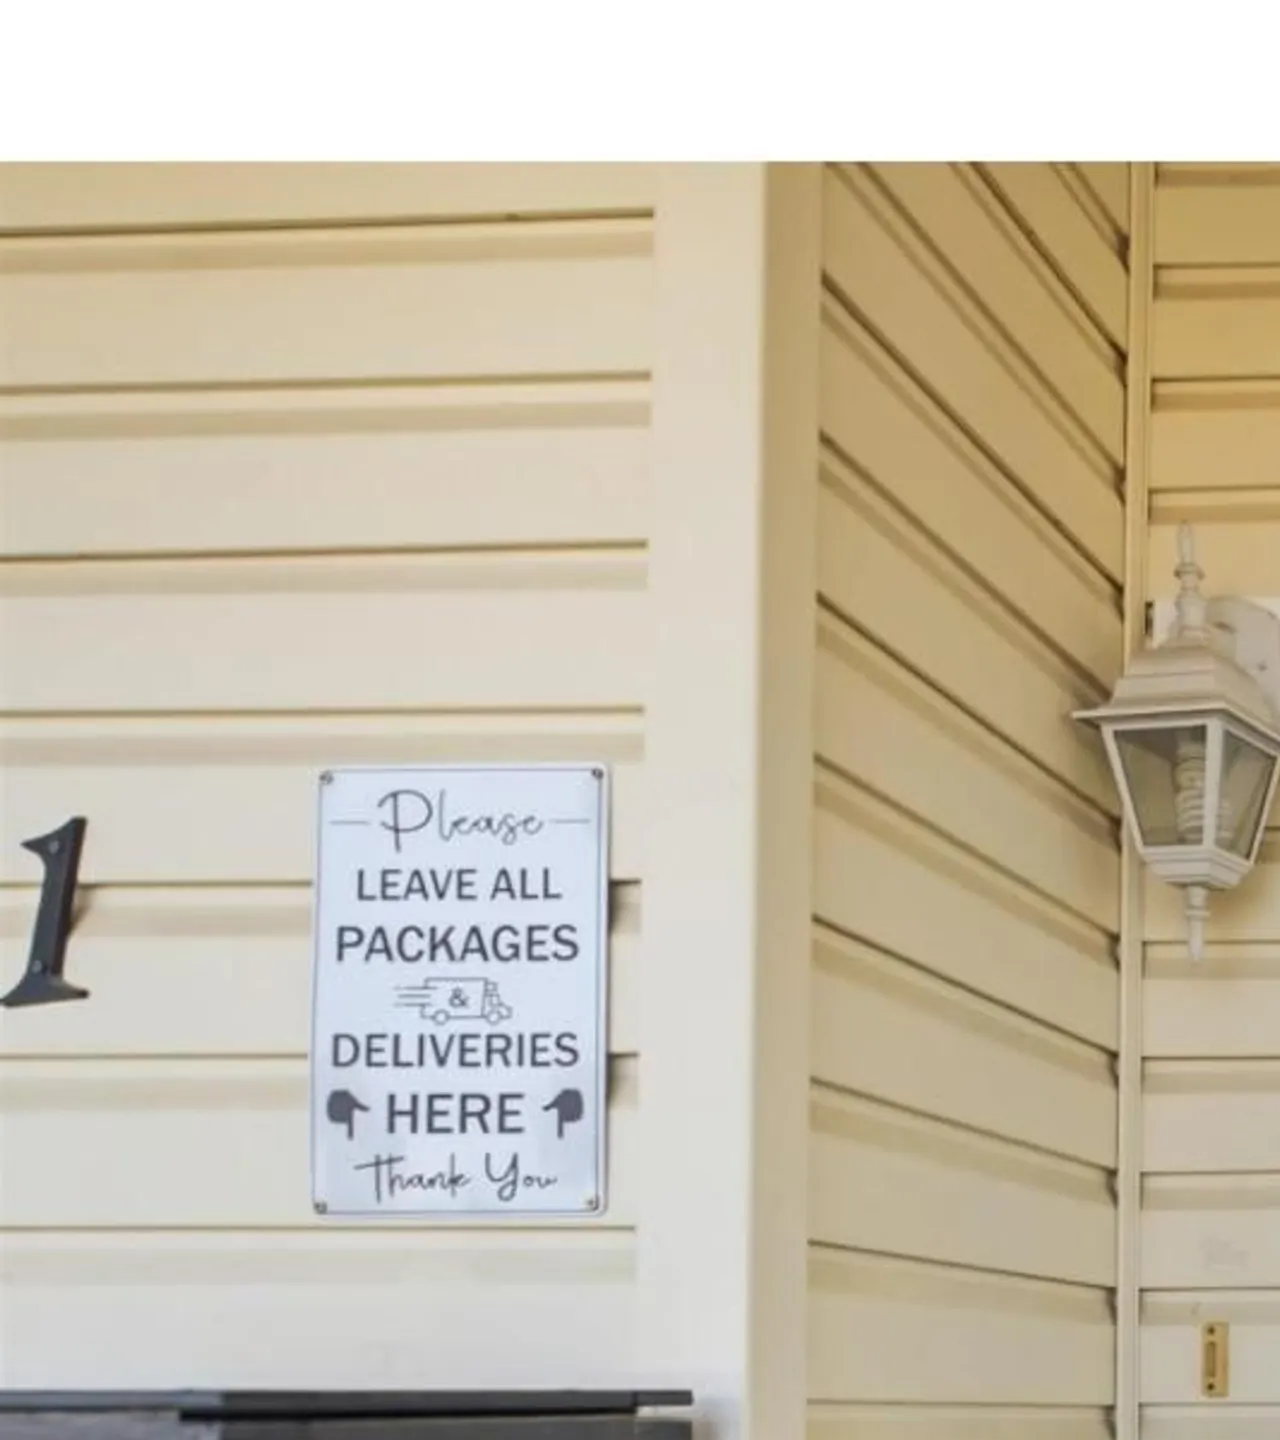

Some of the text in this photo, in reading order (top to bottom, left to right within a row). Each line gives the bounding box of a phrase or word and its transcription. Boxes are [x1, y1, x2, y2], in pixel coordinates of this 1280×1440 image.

[377, 788, 545, 854] Please
[356, 868, 563, 901] LEAVE ALL
[335, 925, 580, 963] PACKAGES
[449, 986, 469, 1008] &
[332, 1032, 580, 1068] DELIVERIES
[386, 1093, 526, 1134] HERE
[354, 1152, 558, 1204] Thank You
